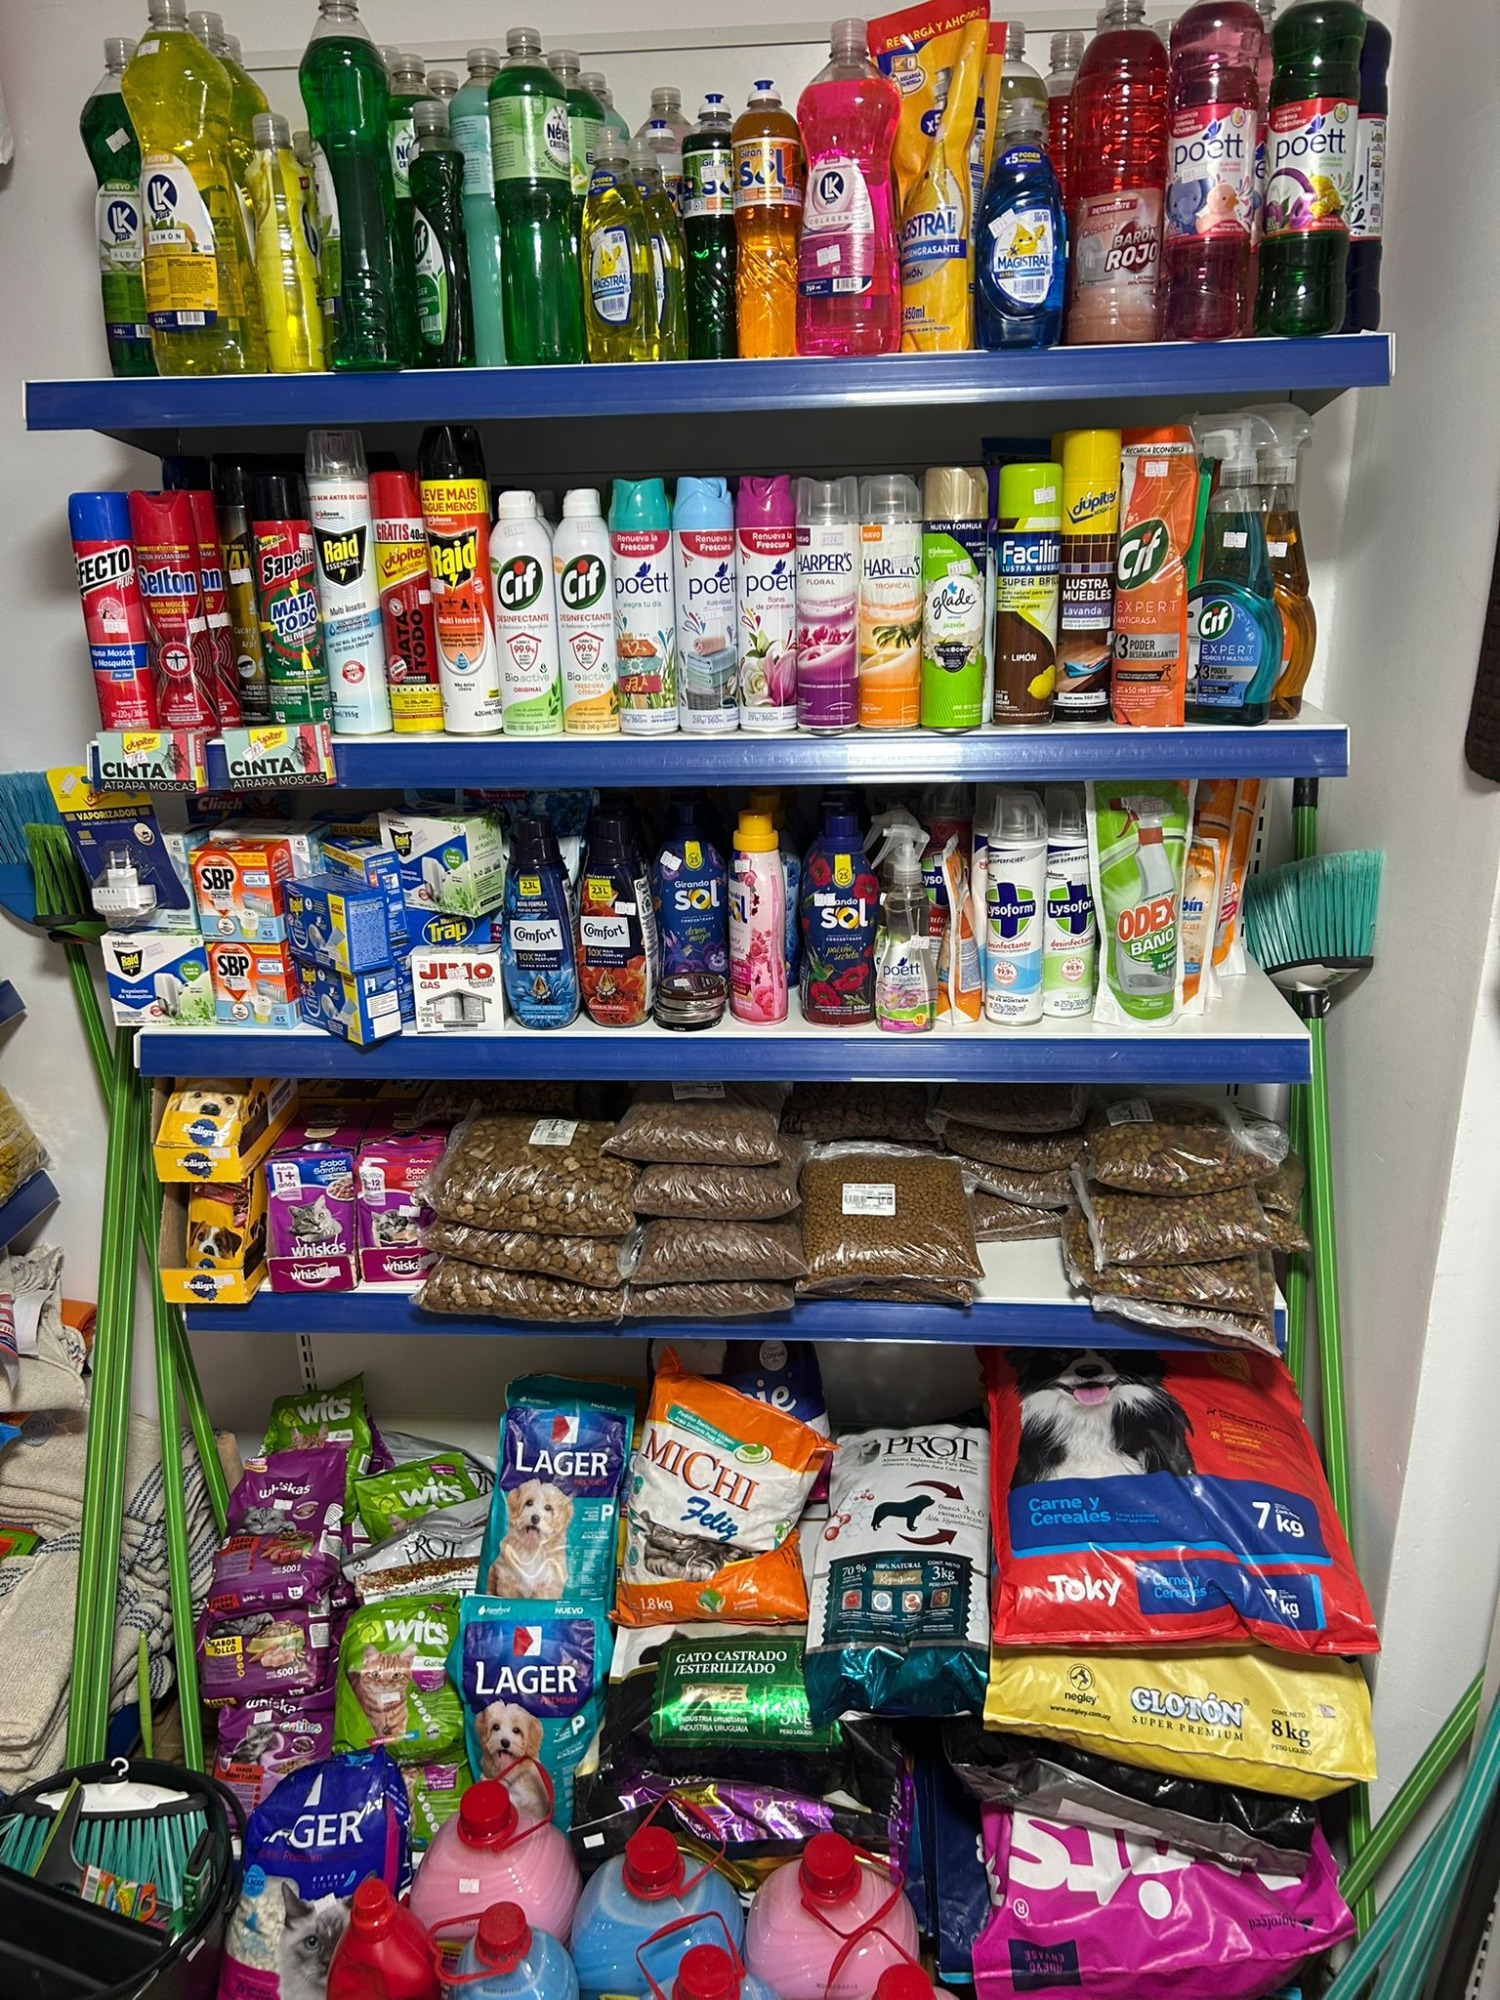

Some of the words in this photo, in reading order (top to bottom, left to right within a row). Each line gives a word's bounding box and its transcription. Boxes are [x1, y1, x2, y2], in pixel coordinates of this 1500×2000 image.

[935, 20, 943, 33] Y
[1175, 133, 1243, 172] poett
[1276, 128, 1346, 168] poett
[739, 149, 786, 187] sol
[151, 231, 182, 242] LIMÓN
[997, 255, 1050, 270] MAGISTRAL
[1105, 242, 1158, 272] ROJO
[593, 275, 628, 290] MAGISTRAL
[1125, 446, 1151, 454] RECARGA
[1152, 445, 1185, 454] ECONÓMICA
[449, 488, 477, 500] MAIS
[449, 501, 477, 512] MENOS
[617, 534, 650, 543] Renueva
[650, 533, 658, 542] la
[695, 535, 728, 544] Renueva
[753, 532, 786, 541] Renueva
[323, 534, 359, 565] Raid
[620, 542, 655, 551] Frescura
[700, 543, 731, 551] Frescura
[756, 541, 790, 549] Frescura
[326, 558, 360, 571] ESSENCIAL
[431, 537, 477, 578] Raid
[1117, 529, 1161, 589] Cif
[1002, 565, 1032, 573] LUSTRA
[139, 566, 196, 595] Selton
[500, 560, 537, 605] Cif
[563, 560, 600, 605] Cif
[615, 574, 670, 600] poett
[1002, 578, 1035, 587] SUPER
[1065, 577, 1109, 590] LUSTRA
[1062, 590, 1112, 601] MUEBLES
[271, 591, 316, 620] MATA
[330, 606, 344, 617] Multi
[933, 588, 977, 620] glade
[1063, 606, 1102, 616] Lavanda
[1117, 600, 1178, 614] EXPERT
[275, 607, 319, 636] TODO
[497, 613, 550, 623] DESINFECTANTE
[560, 613, 612, 622] DESINFECTANTE
[1117, 616, 1157, 625] ANTIGRASA
[1200, 606, 1230, 635] Cif
[411, 609, 427, 670] TODO
[1129, 640, 1155, 650] PODER
[107, 649, 136, 657] Moscas
[1201, 644, 1255, 655] EXPERT
[99, 659, 135, 668] Mosquitos
[1012, 653, 1037, 662] LIMÓN
[1194, 664, 1210, 680] X3
[1211, 666, 1227, 674] PODER
[102, 762, 167, 779] CINTA
[230, 757, 297, 777] CINTA
[104, 781, 146, 791] ATRAPA
[150, 781, 196, 792] MOSCAS
[233, 778, 277, 790] ATRAPA
[281, 773, 327, 786] MOSCAS
[197, 796, 243, 811] Clinch
[76, 808, 138, 822] VAPORIZADOR
[690, 855, 699, 863] 25
[201, 869, 235, 890] SBP
[839, 871, 849, 880] 25
[675, 880, 710, 889] Girando
[675, 879, 720, 911] sol
[821, 898, 869, 930] sol
[1118, 893, 1177, 943] ODEX
[428, 919, 468, 943] Trap
[514, 926, 558, 944] Comfort
[584, 922, 625, 940] Comfort
[519, 952, 534, 962] 10X
[588, 948, 602, 958] 10X
[120, 955, 140, 970] Raid
[218, 955, 249, 977] SBP
[883, 962, 920, 978] poett
[420, 981, 441, 989] GAS
[176, 1158, 218, 1169] Pedigree
[313, 1165, 347, 1175] Sardina
[320, 1159, 347, 1169] Sabor
[276, 1171, 295, 1183] 1+
[291, 1240, 346, 1257] whiskas
[298, 1397, 351, 1425] wits
[516, 1442, 608, 1478] LAGER
[643, 1429, 759, 1511] MICHI
[400, 1477, 466, 1507] wits
[1028, 1497, 1083, 1512] Carne
[1087, 1496, 1100, 1514] y
[681, 1495, 740, 1542] Feliz
[1031, 1510, 1111, 1527] Cereales
[1252, 1501, 1272, 1530] 7
[1276, 1513, 1306, 1538] kg
[842, 1565, 855, 1577] 70
[891, 1562, 922, 1570] NATURAL
[931, 1566, 955, 1581] 3kg
[1152, 1574, 1188, 1587] Carne
[1047, 1574, 1122, 1607] Toky
[1153, 1584, 1208, 1599] Cereales
[555, 1606, 584, 1615] NUEVO
[656, 1598, 674, 1613] kg
[1280, 1600, 1300, 1618] kg
[385, 1610, 449, 1645] wits
[676, 1652, 712, 1664] GATO
[714, 1650, 788, 1663] CASTRADO
[674, 1662, 777, 1677] /ESTERILIZADO
[475, 1661, 578, 1696] LAGER
[539, 1696, 578, 1705] PREMIUM
[1064, 1690, 1098, 1706] negley
[1050, 1704, 1112, 1722] www.negley.com.uy
[1131, 1686, 1244, 1727] GLOTÓN
[1290, 1710, 1307, 1718] NETO
[679, 1715, 713, 1723] INDUSTRIA
[713, 1716, 748, 1724] URUGUAYA
[679, 1724, 713, 1732] INDUSTRIA
[714, 1724, 749, 1733] URUGUAIA
[1131, 1716, 1174, 1732] SUPER
[1180, 1724, 1244, 1742] PREMIUM
[1286, 1720, 1312, 1748] kg
[1271, 1744, 1288, 1752] PESO
[312, 1873, 346, 1882] EXTRA
[312, 1881, 339, 1890] LIGHT
[1248, 1914, 1300, 1931] Agrofeed
[1024, 1950, 1065, 1962] ENVASE
[1029, 1962, 1064, 1975] NUEVO
